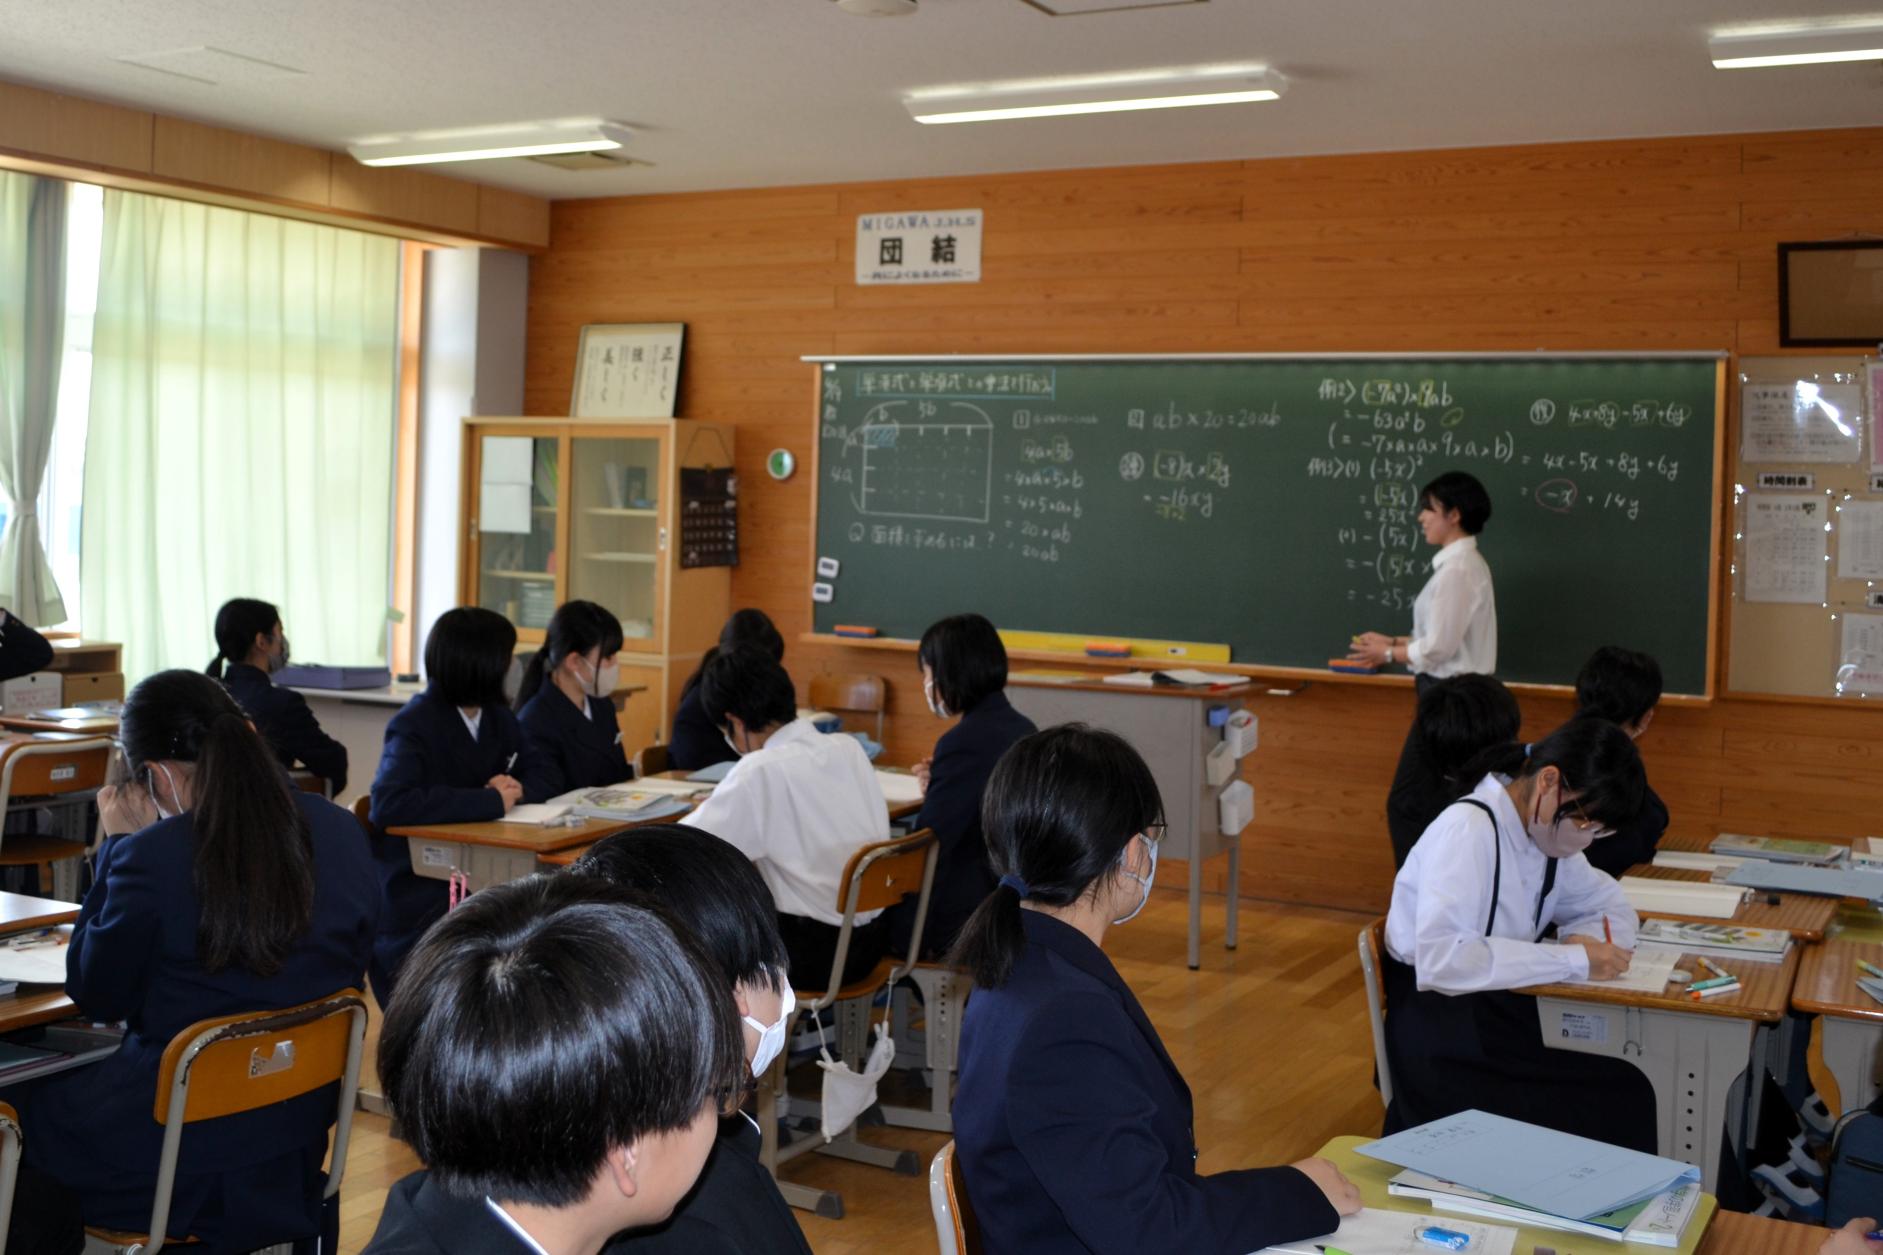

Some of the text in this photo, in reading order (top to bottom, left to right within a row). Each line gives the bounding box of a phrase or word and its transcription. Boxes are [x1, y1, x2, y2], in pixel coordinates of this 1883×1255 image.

[880, 233, 957, 265] 団結
[1764, 475, 1808, 486] 時間割表
